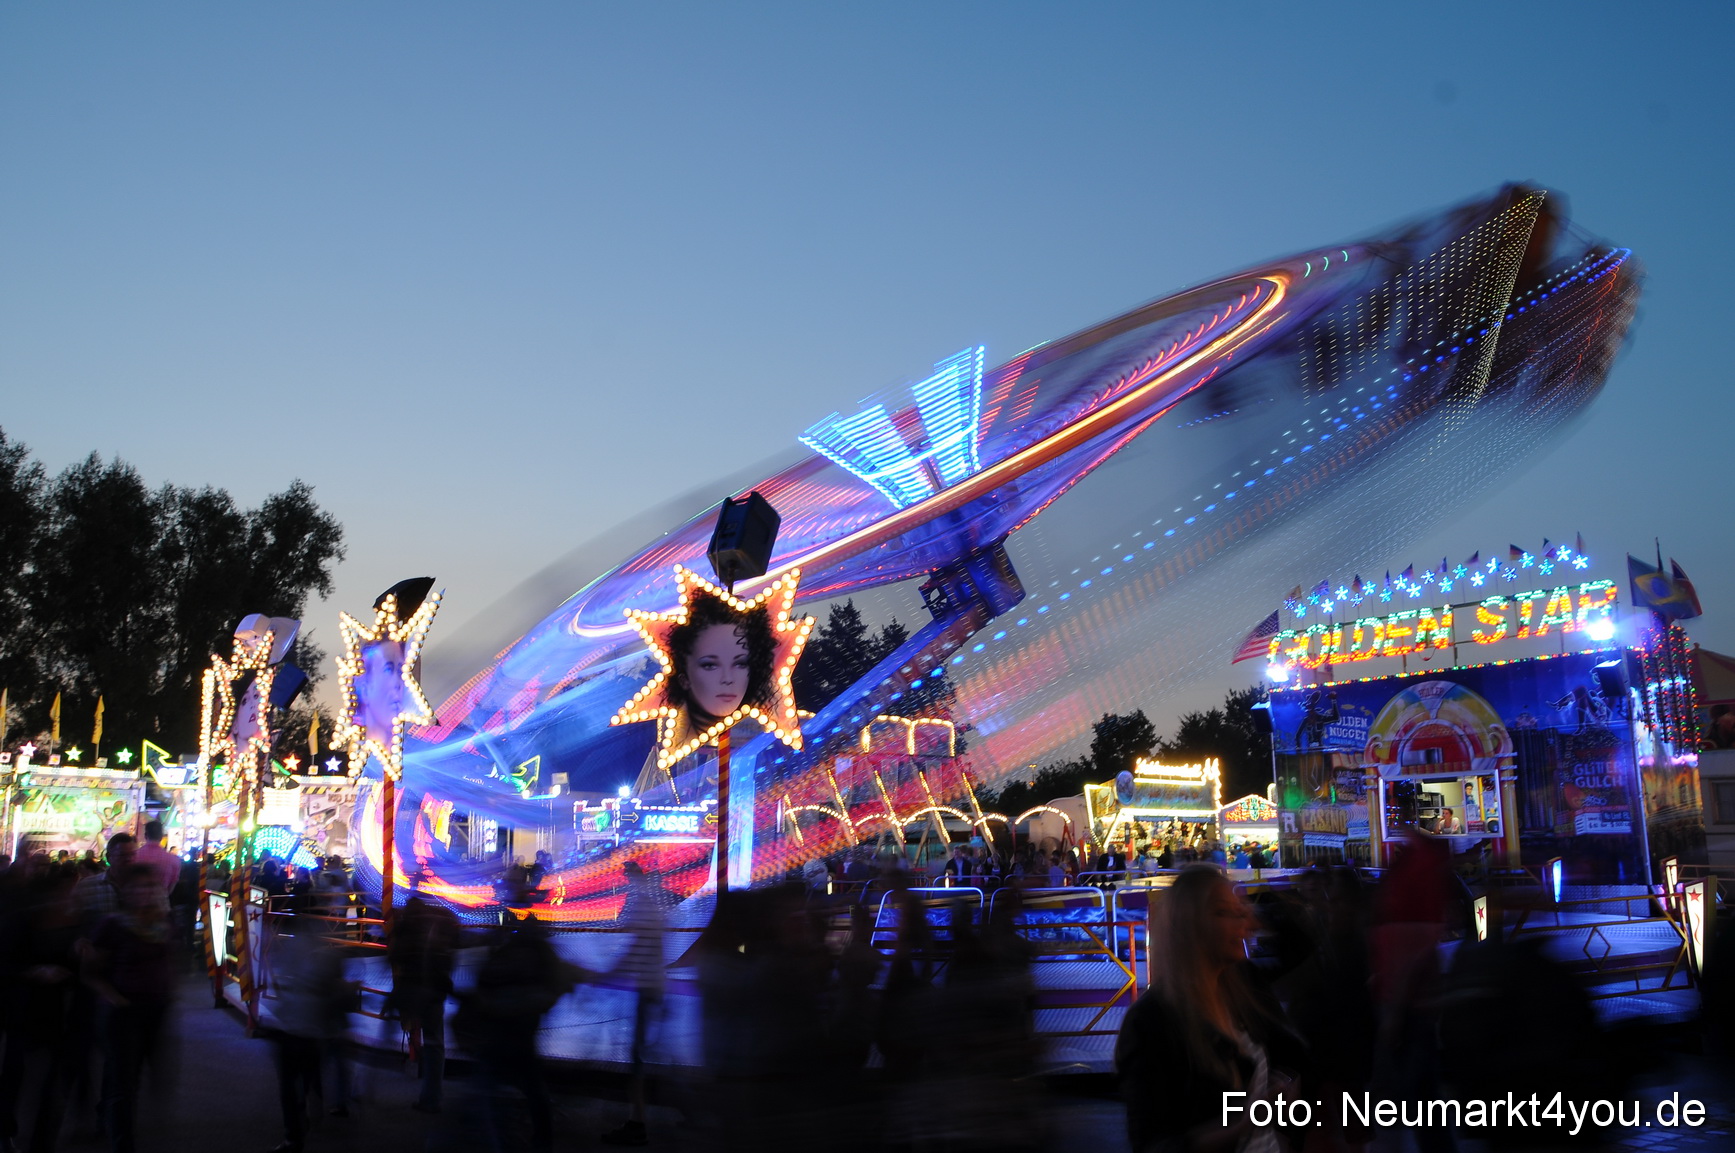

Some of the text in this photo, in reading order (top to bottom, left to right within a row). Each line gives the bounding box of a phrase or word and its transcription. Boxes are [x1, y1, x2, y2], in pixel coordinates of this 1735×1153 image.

[1267, 579, 1618, 670] GOLDEN STAR
[1329, 727, 1367, 741] NUGGET
[1574, 776, 1622, 789] GULCH
[645, 814, 699, 832] KASSE
[1301, 808, 1347, 834] CASINO
